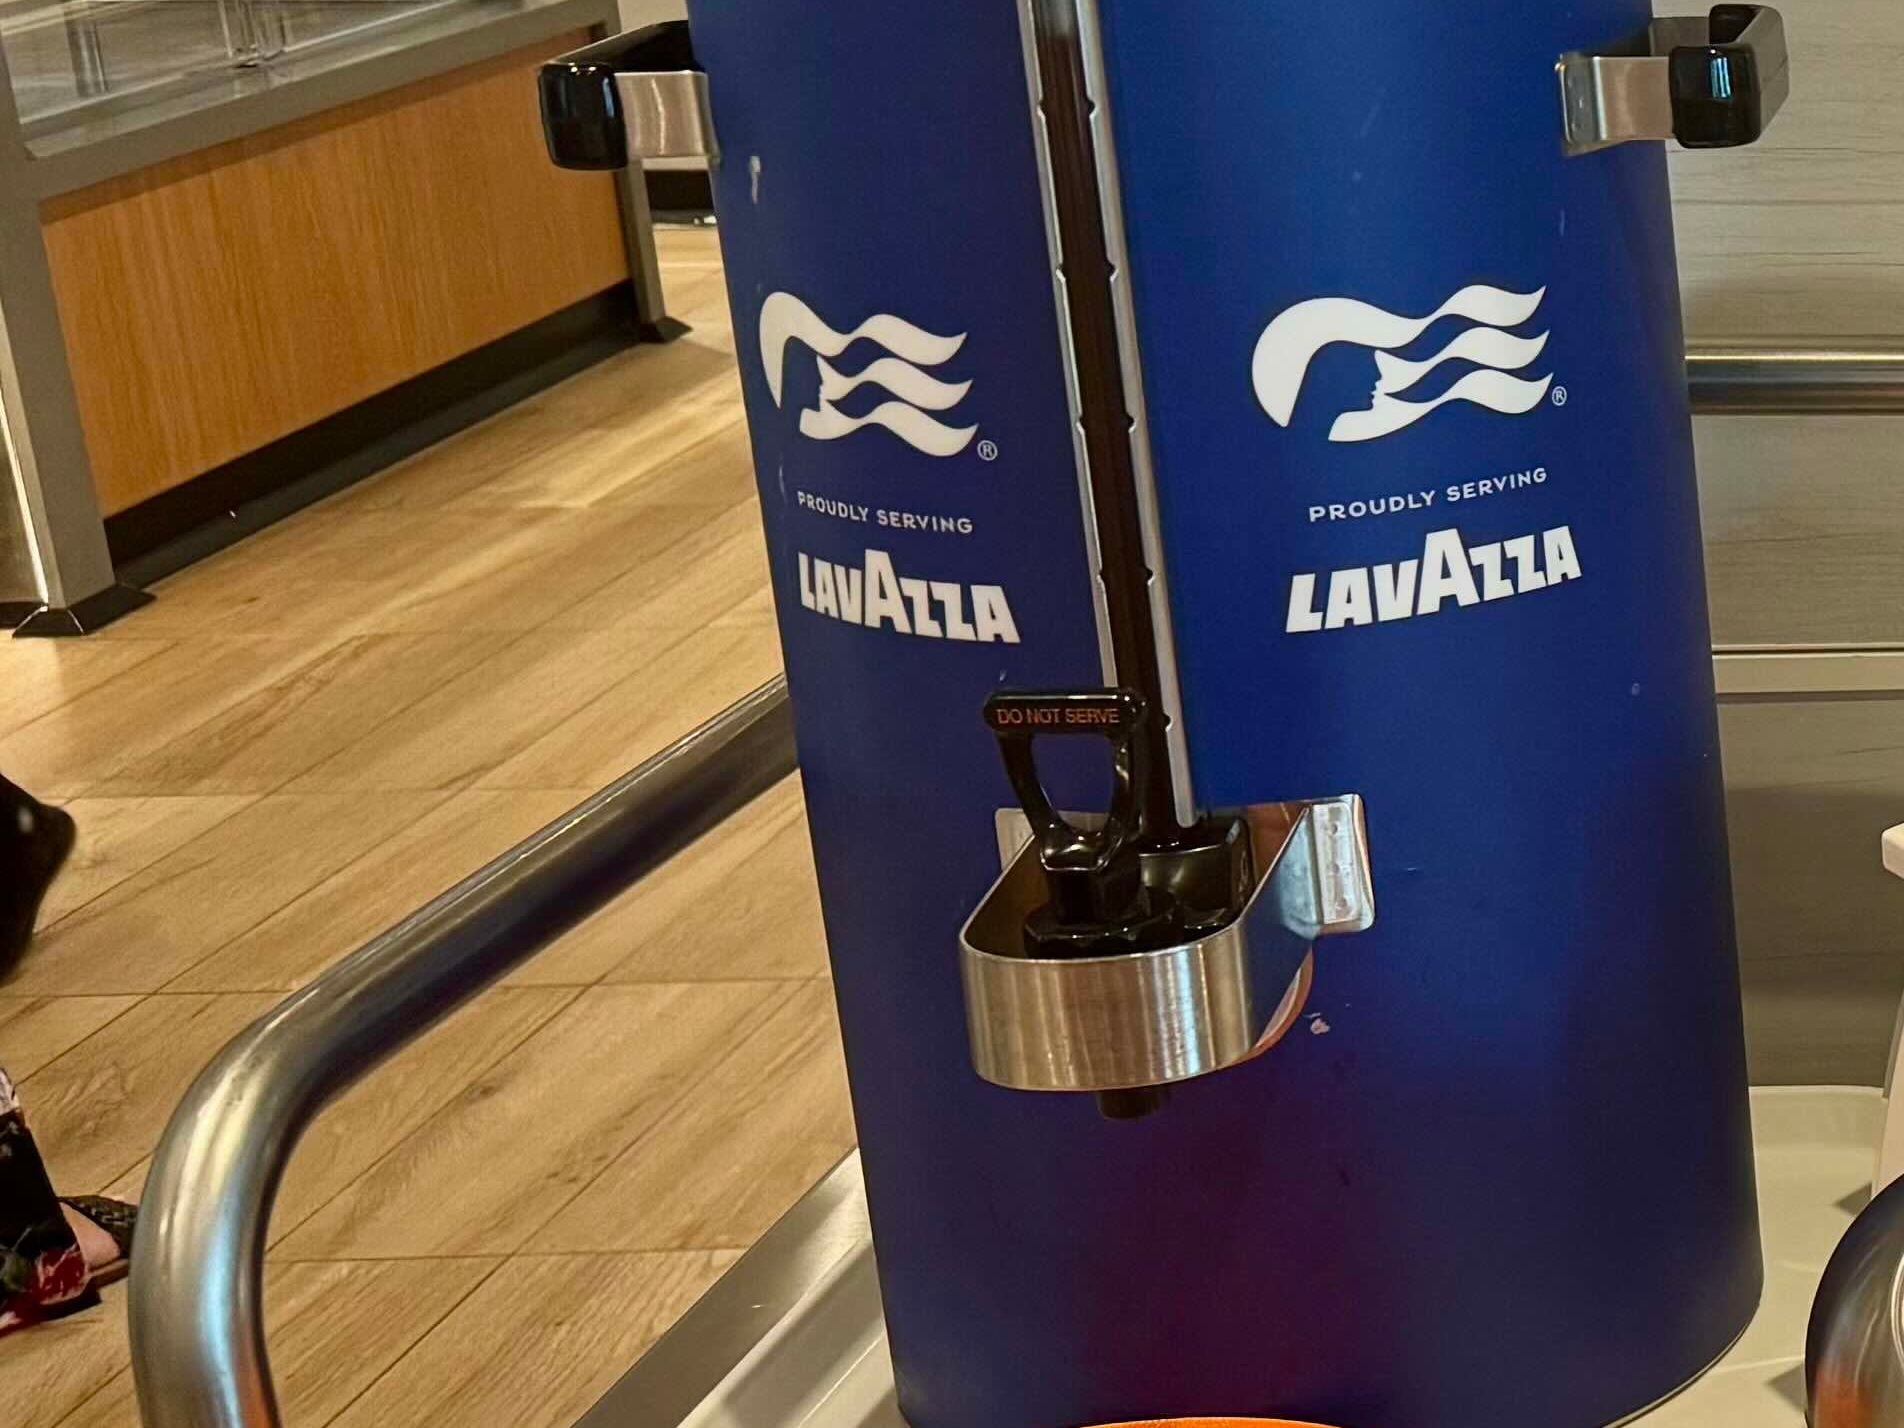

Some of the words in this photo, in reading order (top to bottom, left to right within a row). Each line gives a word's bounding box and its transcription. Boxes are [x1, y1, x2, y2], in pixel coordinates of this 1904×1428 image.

[797, 491, 869, 522] PROUDLY
[876, 509, 973, 534] SERVING
[1309, 490, 1436, 522] PROUDLY
[1446, 467, 1548, 502] SERVING
[798, 548, 1021, 644] LAVAZZA
[1285, 525, 1583, 633] LAVAZZA
[996, 708, 1023, 724] DO
[1026, 708, 1060, 724] NOT
[1065, 708, 1120, 724] SERVE
